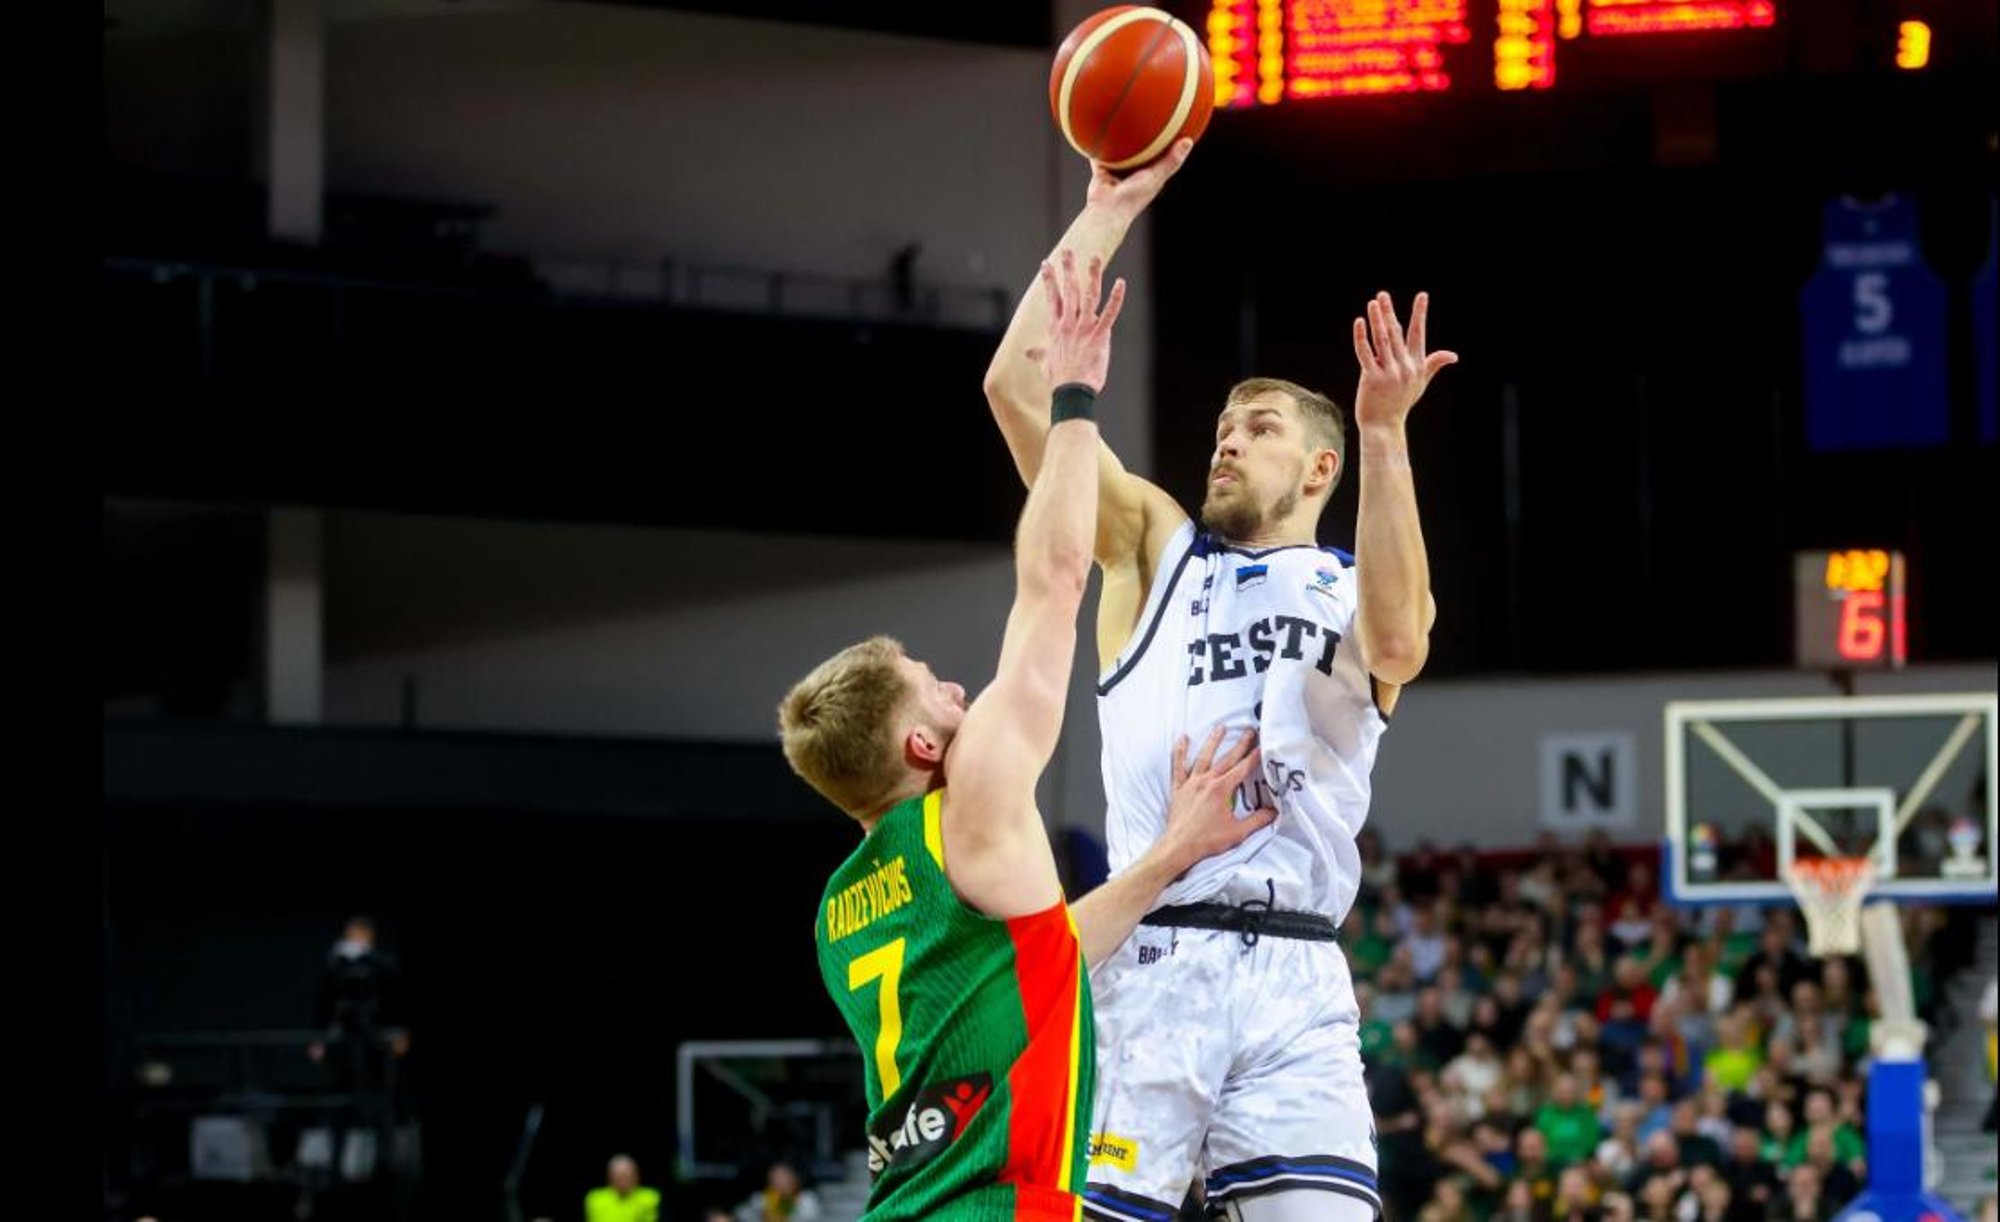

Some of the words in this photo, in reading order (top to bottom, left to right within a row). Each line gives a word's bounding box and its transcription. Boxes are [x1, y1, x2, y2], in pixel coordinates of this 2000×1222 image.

[1854, 273, 1892, 332] 5
[1839, 590, 1885, 660] 6
[1561, 750, 1614, 811] N
[849, 937, 905, 1101] 7
